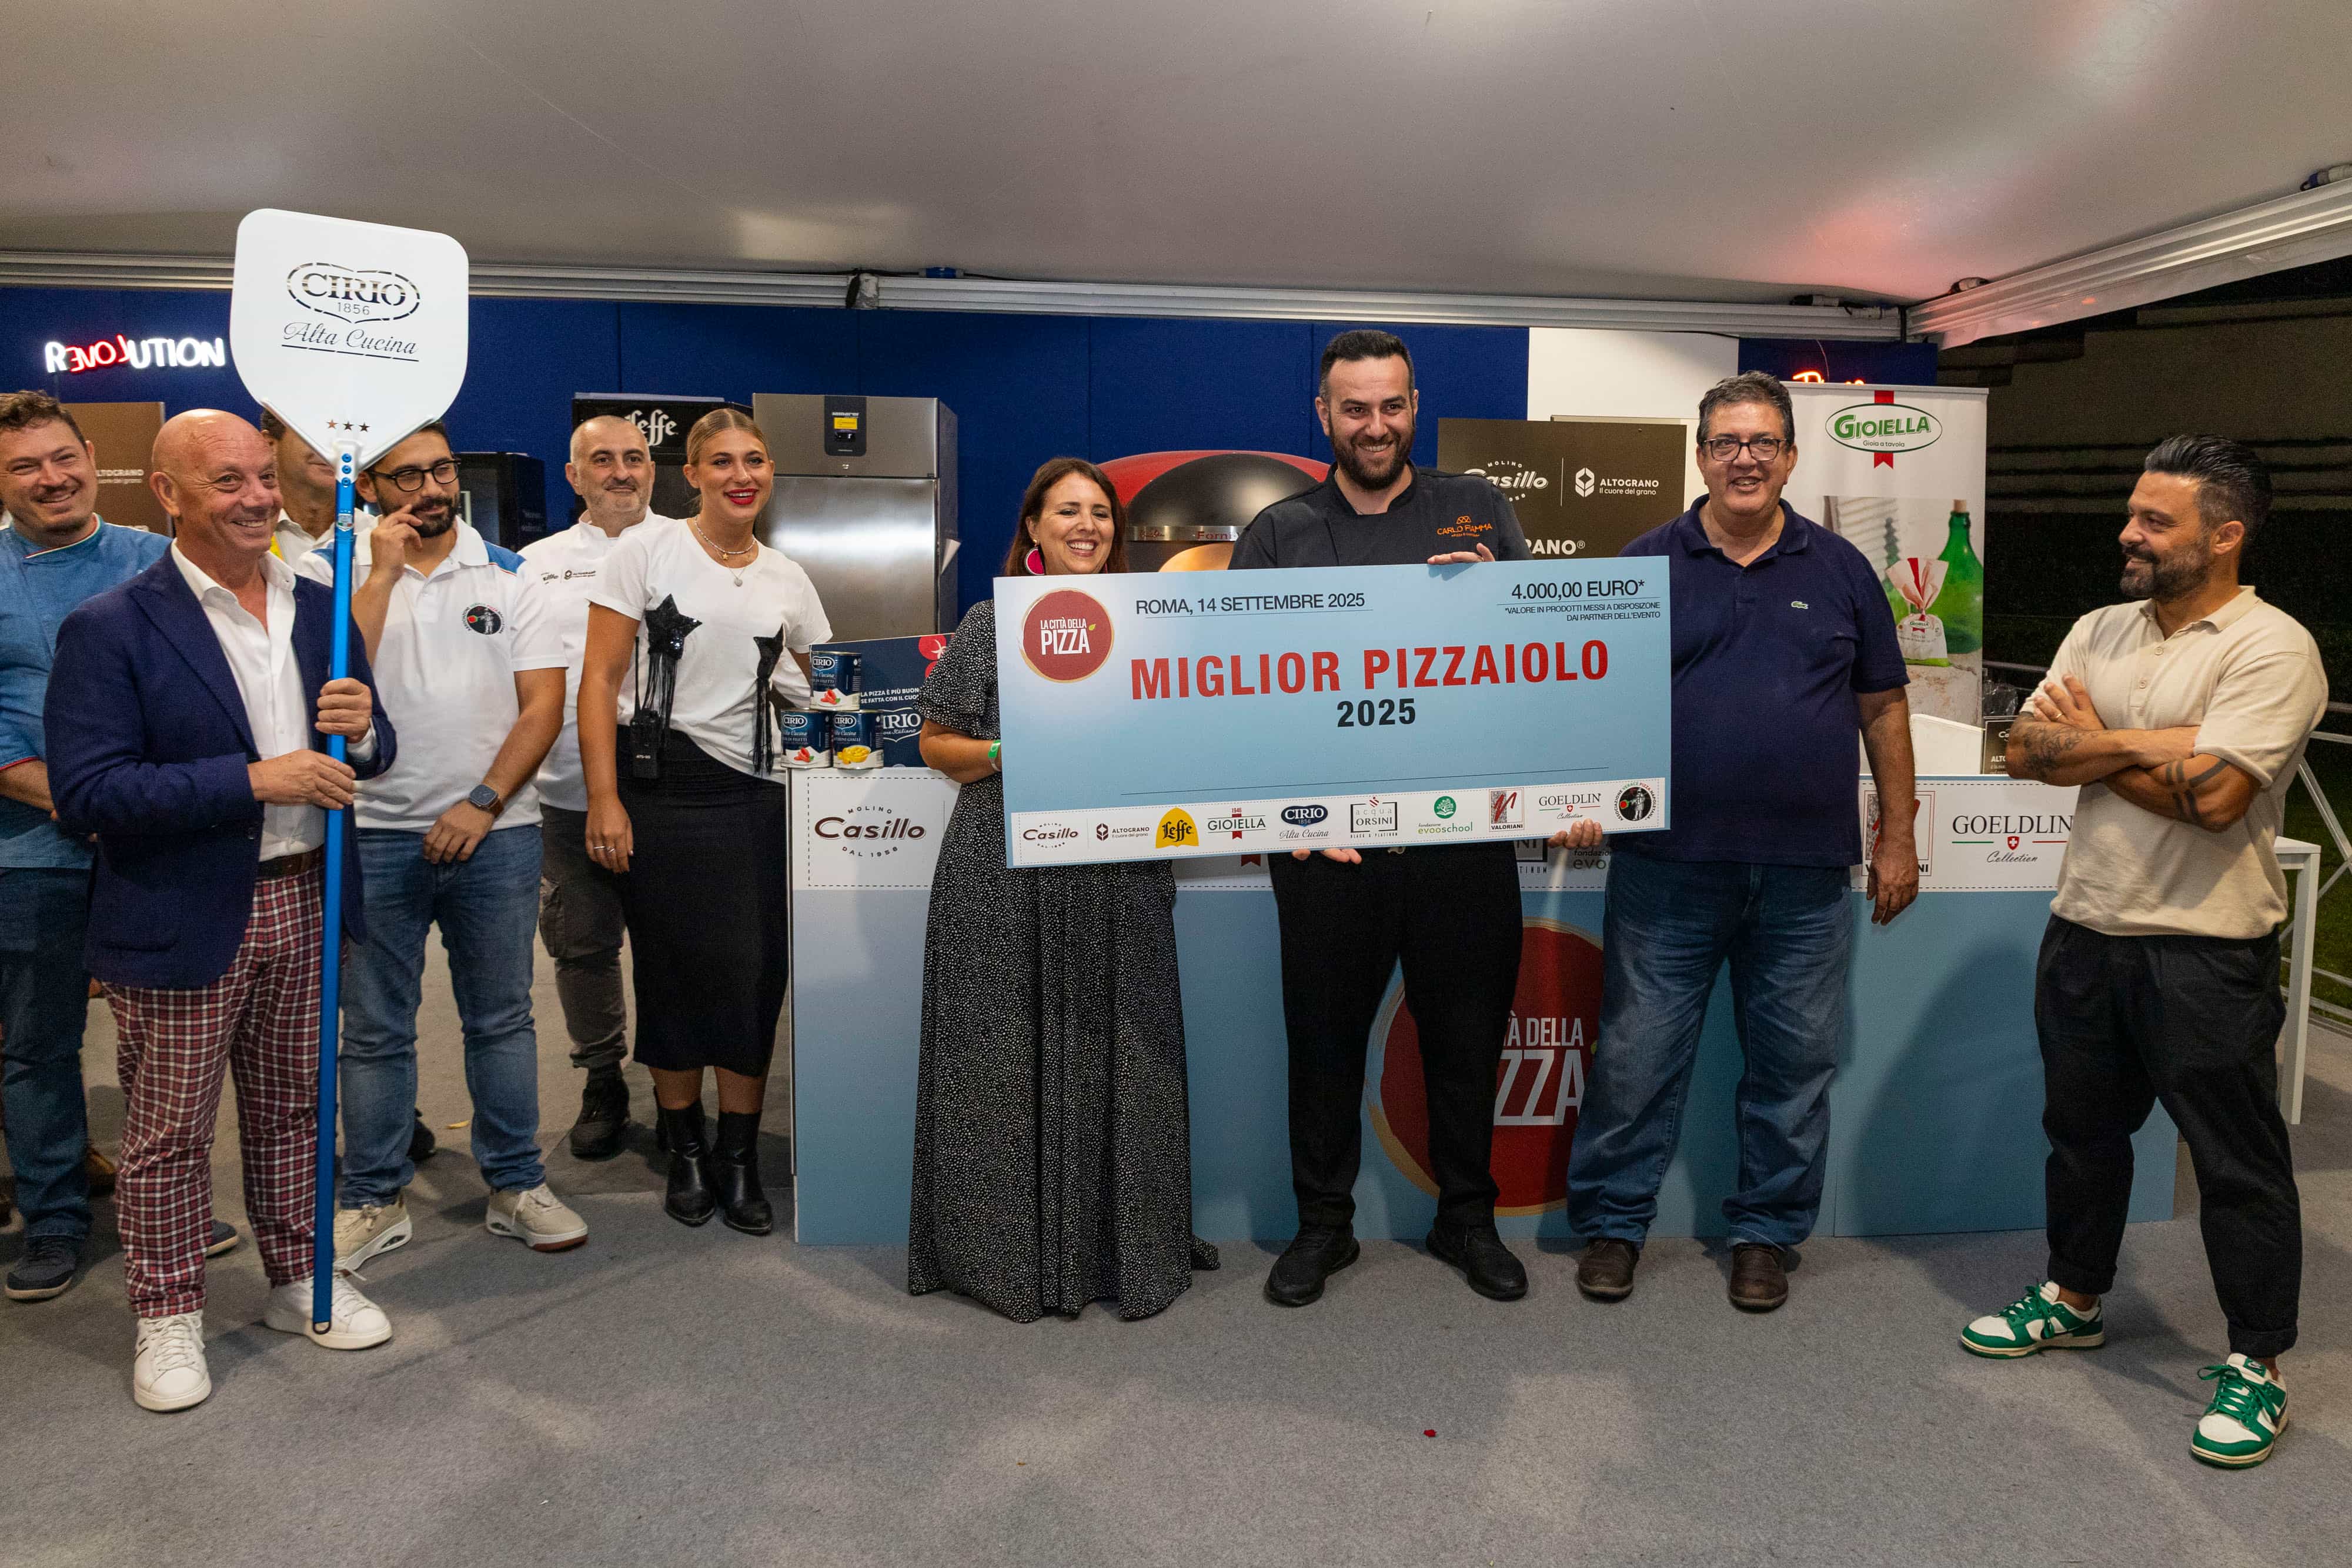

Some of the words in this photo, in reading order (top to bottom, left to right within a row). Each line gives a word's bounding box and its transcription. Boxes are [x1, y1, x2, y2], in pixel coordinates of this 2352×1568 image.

[302, 273, 406, 306] CIRIO
[338, 302, 370, 316] 1856
[283, 322, 340, 346] Alta
[346, 329, 418, 355] Cucina
[1834, 414, 1932, 440] GIOIELLA
[1600, 478, 1659, 487] ALTOGRANO
[1436, 526, 1464, 535] CARLO
[1511, 581, 1582, 600] 4.000,00
[1135, 599, 1193, 616] ROMA,
[1197, 597, 1217, 613] 14
[1221, 594, 1324, 611] SETTEMBRE
[1328, 593, 1365, 608] 2025
[1614, 611, 1661, 620] DELL'EVENTO
[1040, 620, 1049, 630] LA
[1050, 617, 1067, 629] CITTÀ
[1067, 618, 1087, 628] DELLA
[1041, 628, 1091, 656] PIZZA
[1131, 651, 1341, 700] MIGLIOR
[1364, 640, 1609, 690] PIZZAIOLO
[1337, 698, 1416, 728] 2025
[883, 713, 921, 729] IRIO
[848, 805, 892, 814] MOLINO
[1614, 790, 1623, 821] ASSOCIAZIONE
[1284, 807, 1324, 820] CIRIO
[814, 817, 926, 840] Casillo
[1208, 818, 1266, 831] GIOIELLA
[1356, 817, 1392, 826] ORSINI
[1418, 821, 1473, 834] evooschool
[1952, 815, 2074, 834] GOELDLIN
[1023, 827, 1078, 840] Casillo
[1162, 819, 1192, 842] Leffe
[1279, 830, 1300, 839] Alta
[1302, 828, 1330, 838] Cucina
[842, 846, 863, 857] DAL
[1573, 848, 1609, 856] fondazio
[1986, 850, 2040, 863] Collection
[1526, 1018, 1584, 1047] DELLA
[1494, 1049, 1585, 1125] ZZA
